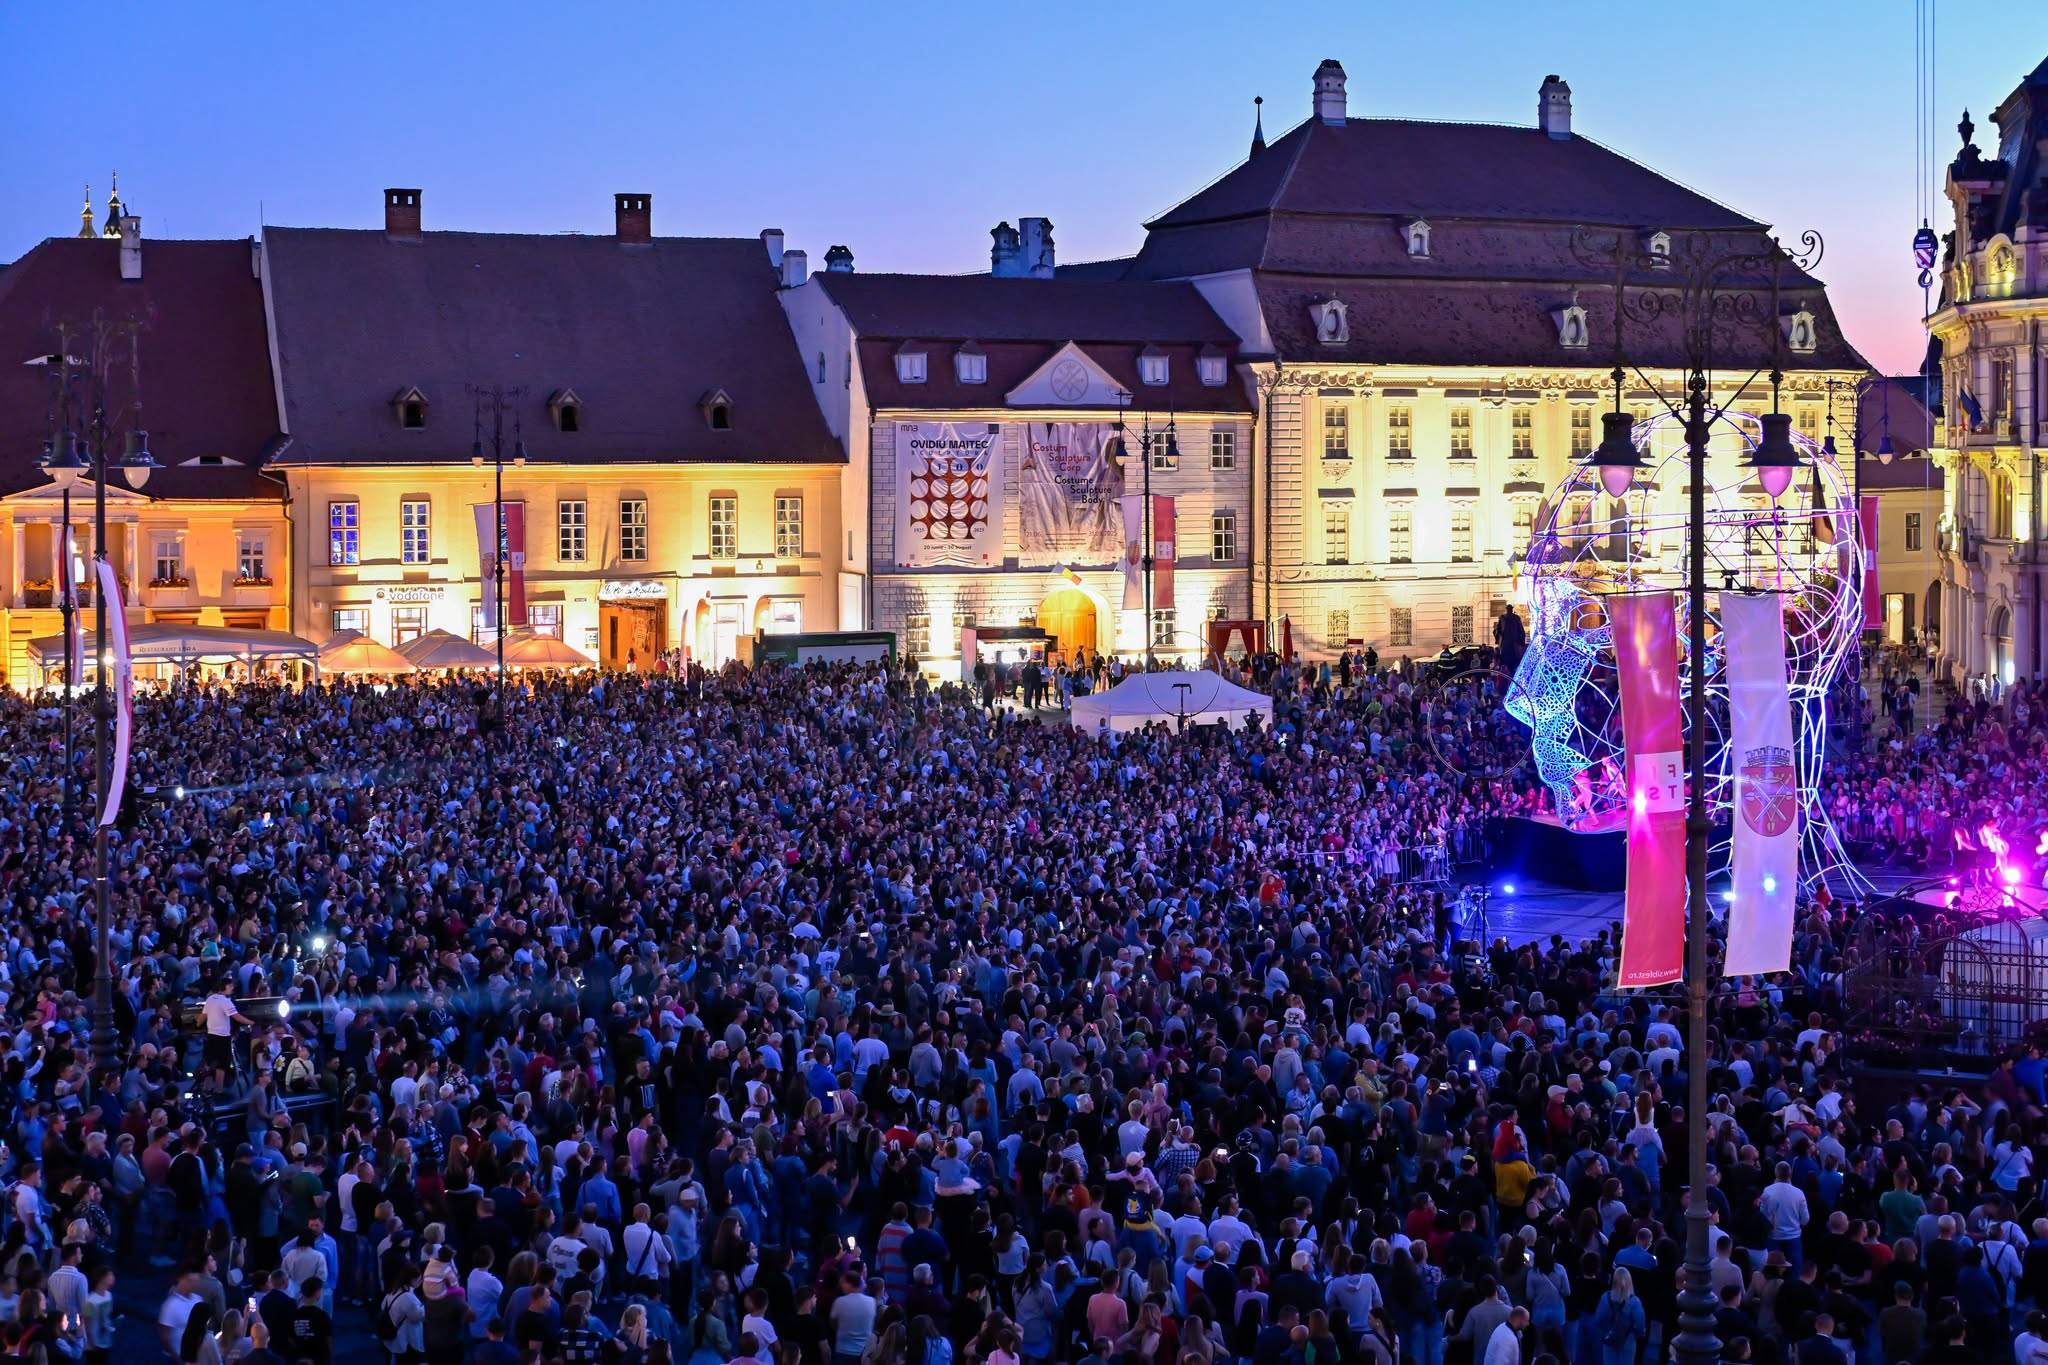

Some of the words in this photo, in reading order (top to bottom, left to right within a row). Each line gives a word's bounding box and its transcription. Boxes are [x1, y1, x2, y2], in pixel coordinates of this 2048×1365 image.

[910, 440, 946, 449] OVIDIU
[948, 440, 989, 449] MAITEC
[1032, 442, 1068, 452] Costum
[1048, 452, 1091, 464] Sculptura
[1059, 462, 1081, 474] Corp
[1054, 474, 1094, 485] Costume
[1070, 485, 1112, 497] Sculpture
[1081, 495, 1104, 505] Body
[389, 590, 445, 600] vodafone
